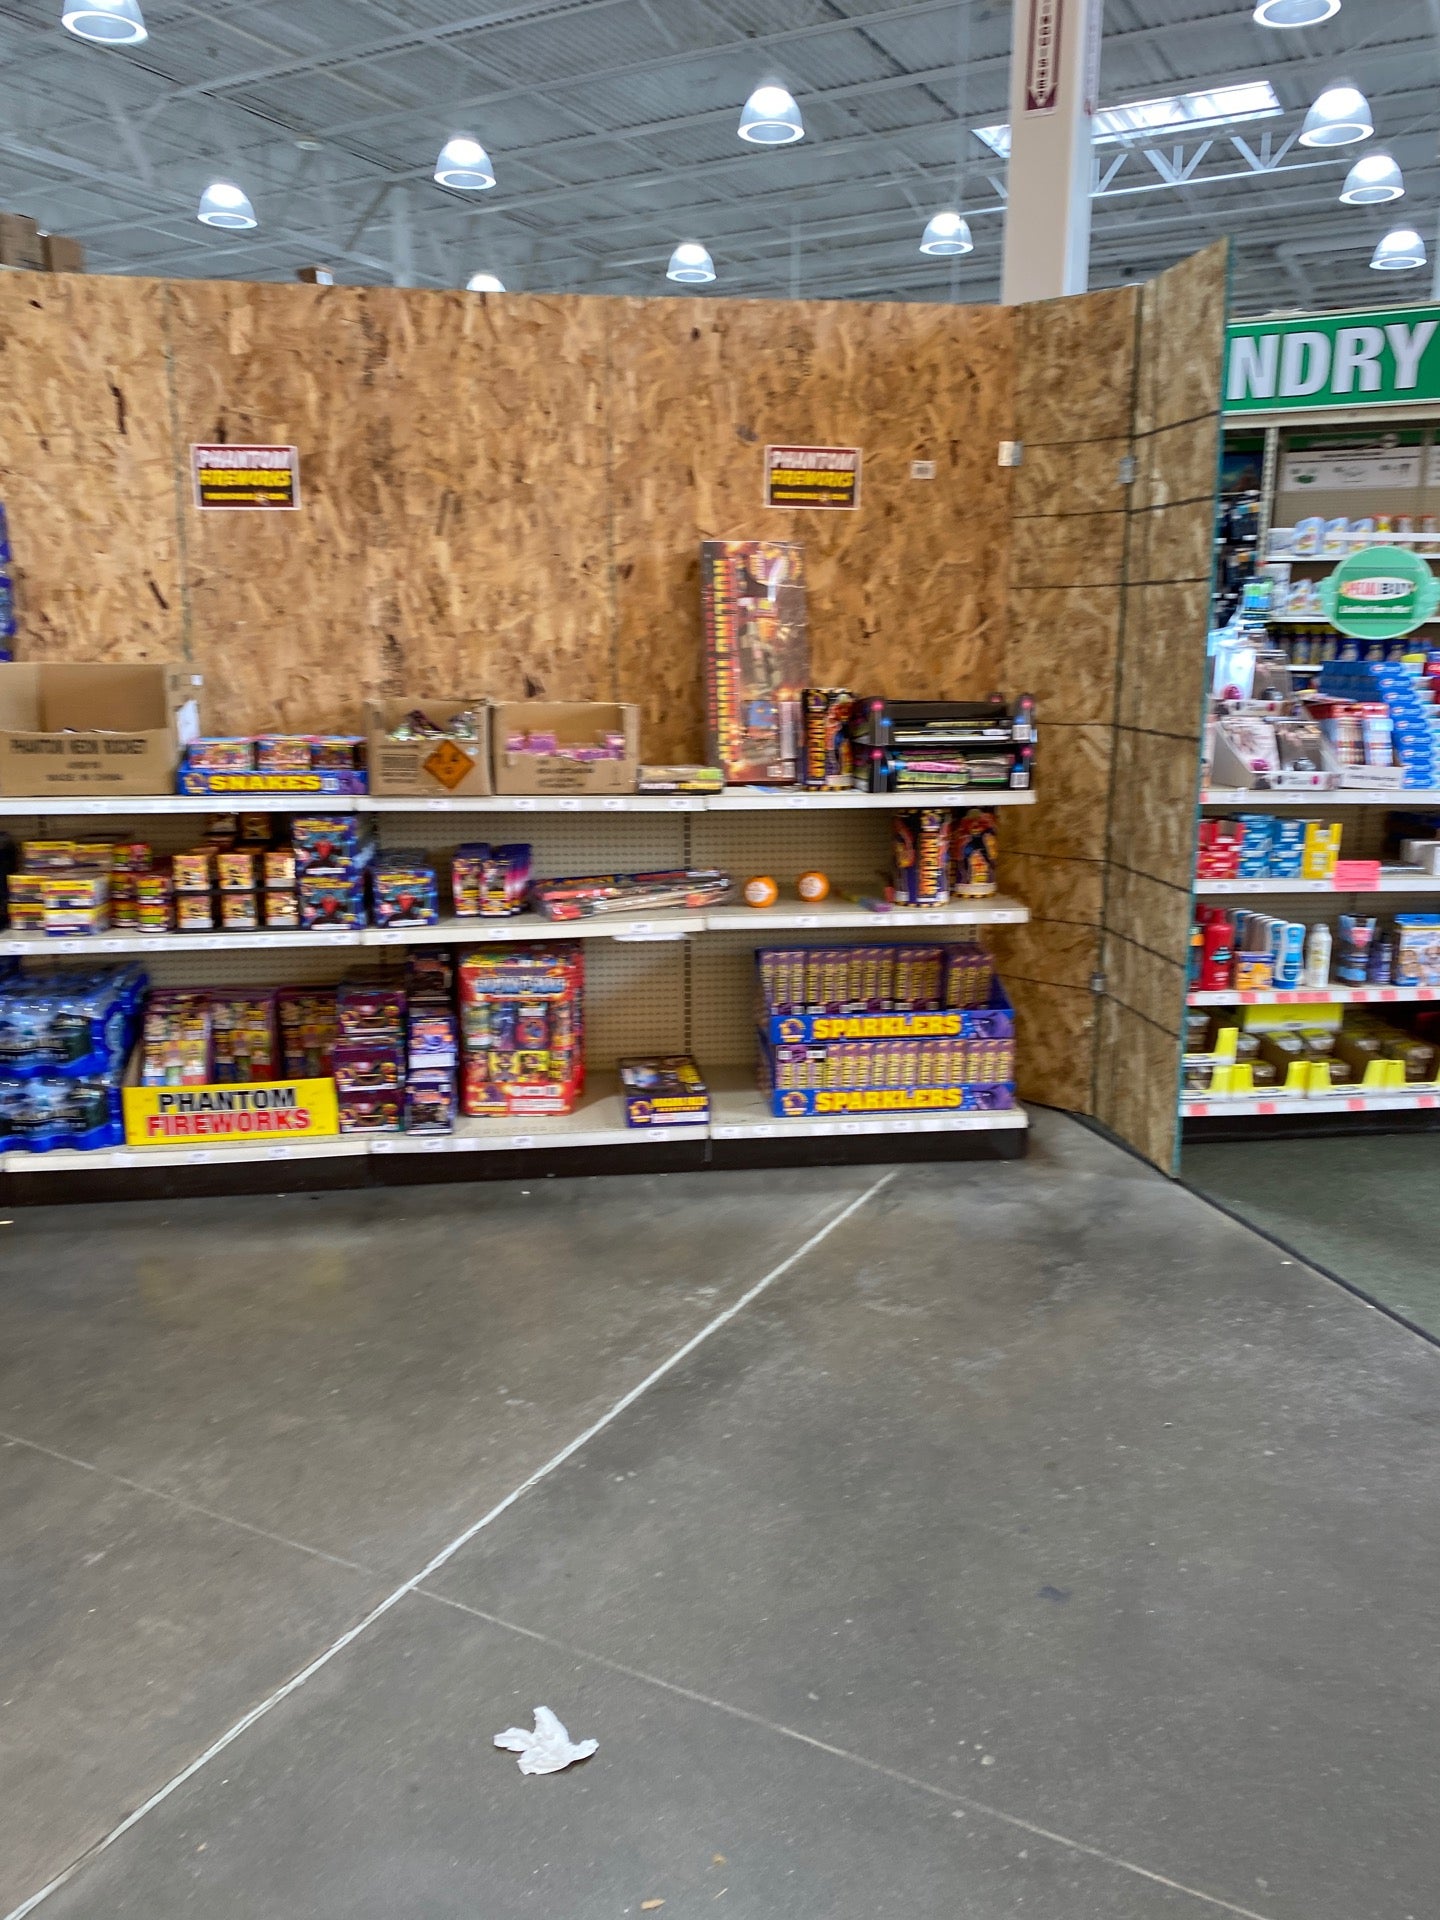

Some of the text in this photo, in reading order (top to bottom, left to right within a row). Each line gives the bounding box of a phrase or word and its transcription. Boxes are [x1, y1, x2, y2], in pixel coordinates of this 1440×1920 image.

[1226, 320, 1440, 400] NDRY
[208, 775, 321, 791] SNAKES
[812, 1014, 962, 1040] SPARKLERS
[157, 1087, 297, 1113] PHANTOM
[815, 1087, 963, 1113] SPARKLERS
[146, 1108, 312, 1137] FIREWORKS
